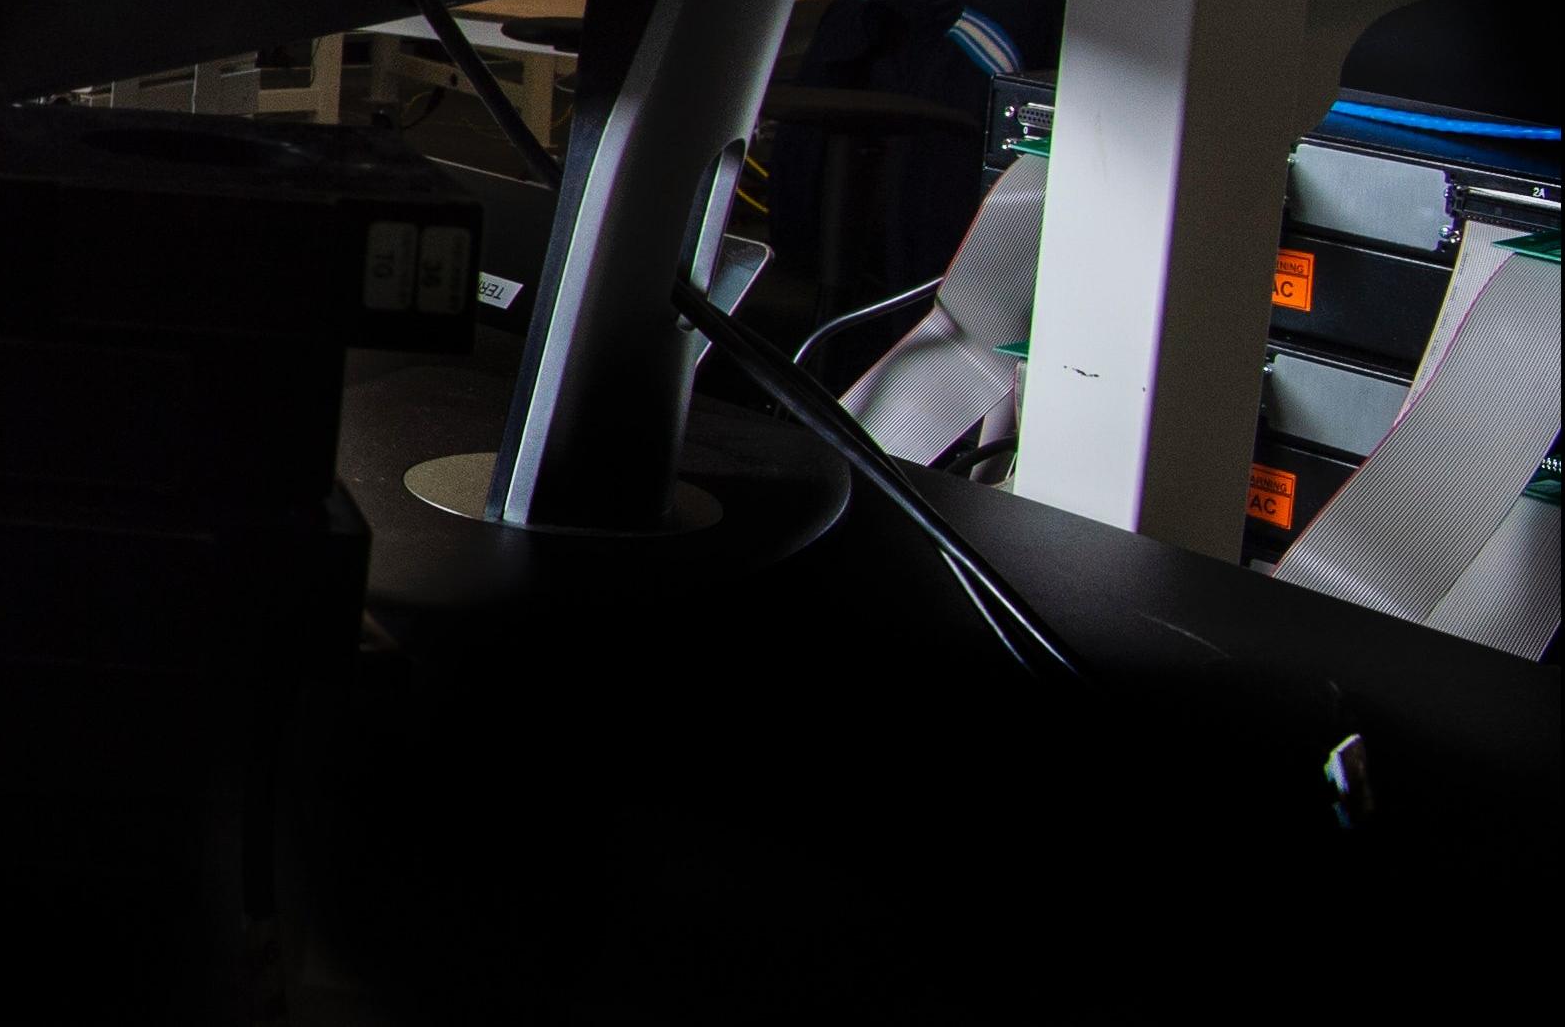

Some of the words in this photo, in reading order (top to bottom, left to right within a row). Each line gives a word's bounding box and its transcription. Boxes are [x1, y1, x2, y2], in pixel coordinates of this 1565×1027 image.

[1276, 260, 1304, 274] NING
[478, 278, 505, 300] TER
[1250, 494, 1276, 514] AC
